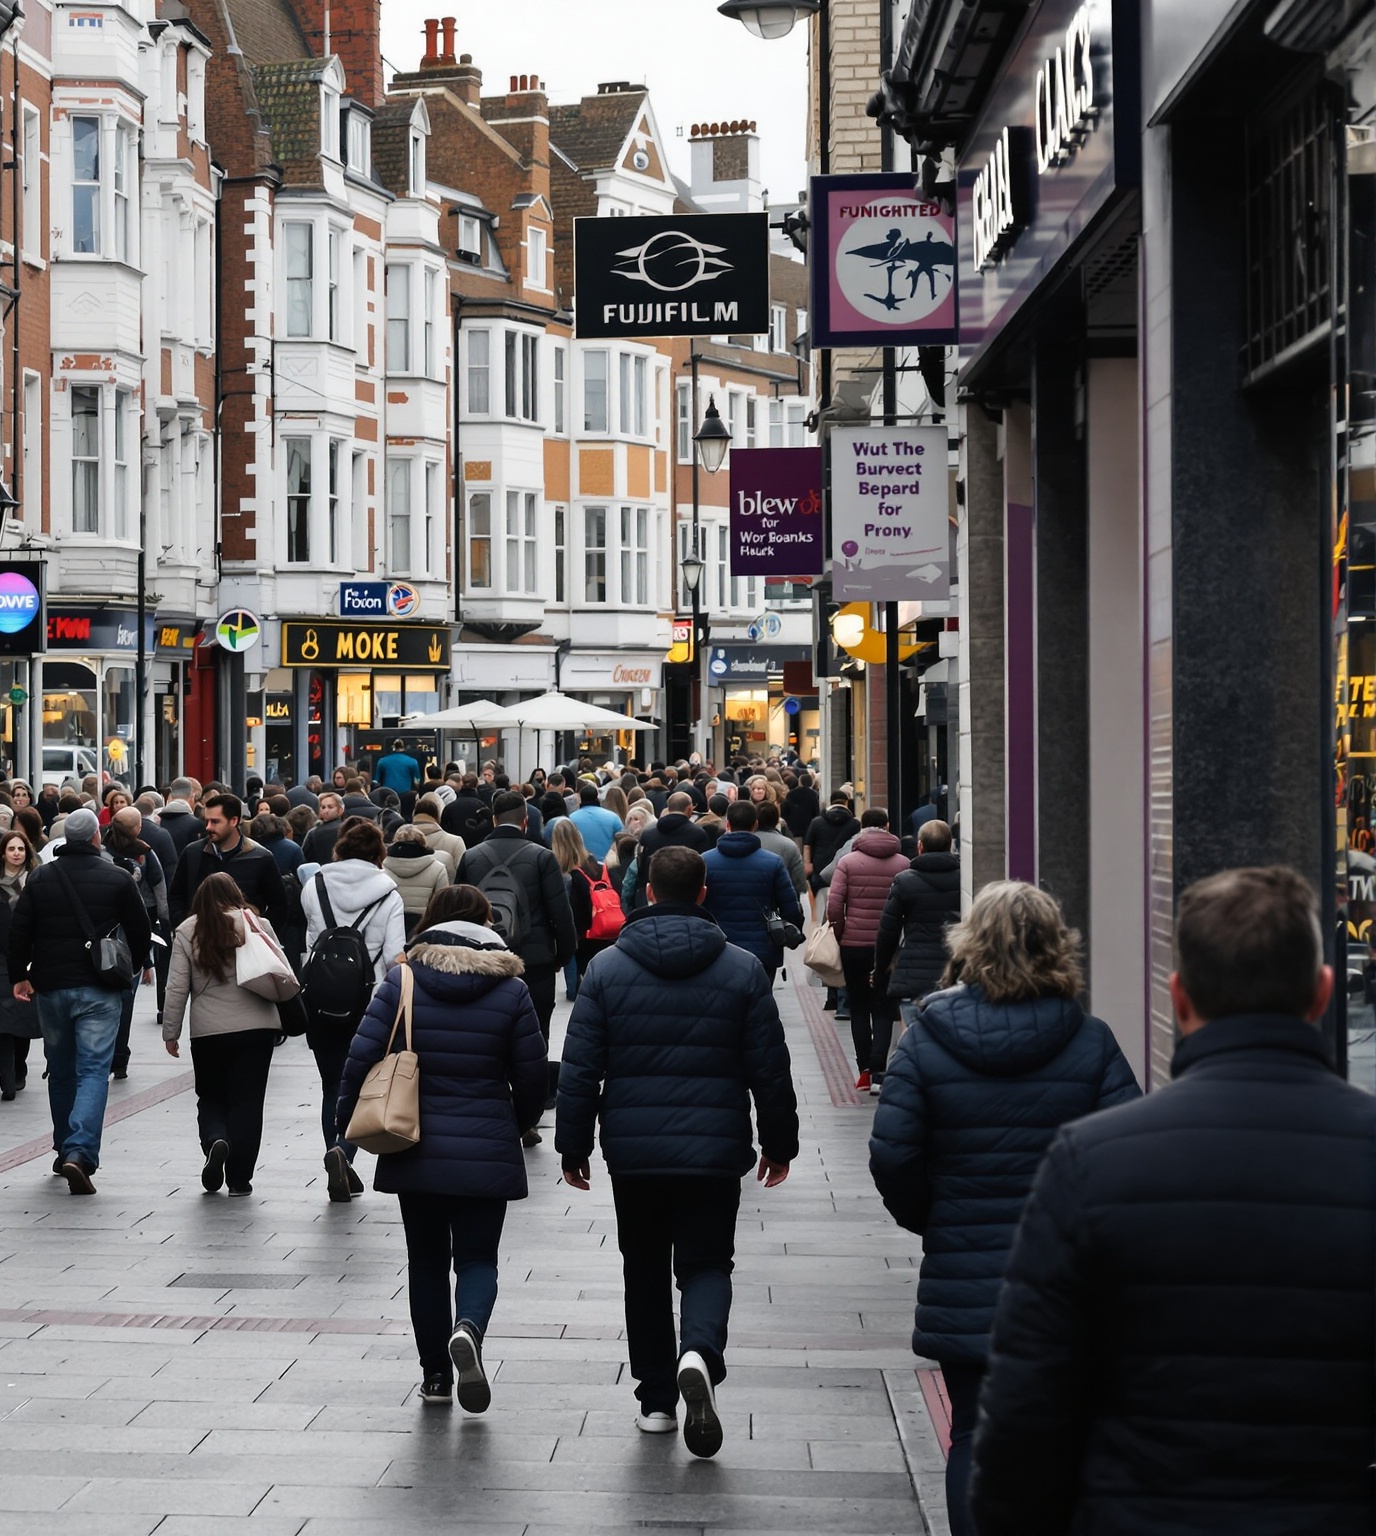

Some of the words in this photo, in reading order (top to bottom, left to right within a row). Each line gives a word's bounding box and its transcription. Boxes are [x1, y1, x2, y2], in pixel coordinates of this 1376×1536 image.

[603, 301, 738, 323] FUJIFILM
[893, 442, 925, 456] The
[738, 490, 798, 515] blew
[878, 502, 902, 516] for
[336, 631, 399, 660] MOKE
